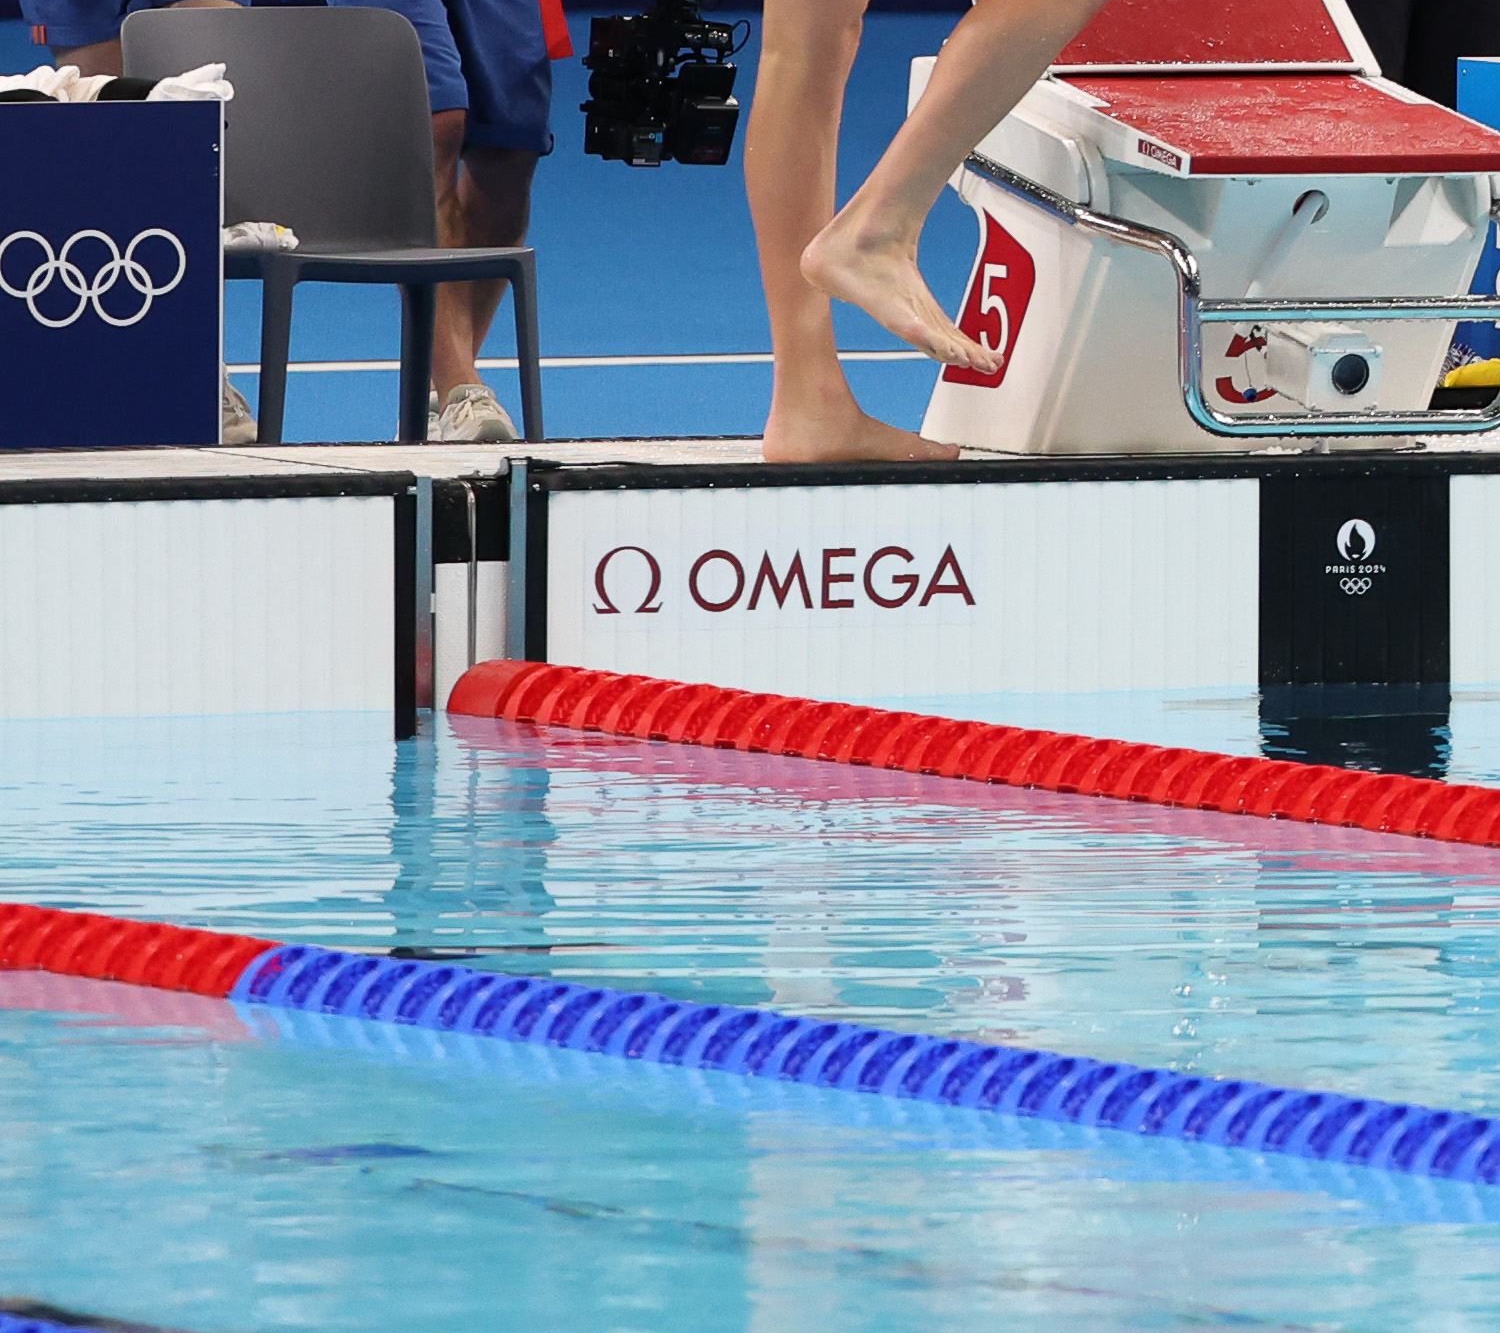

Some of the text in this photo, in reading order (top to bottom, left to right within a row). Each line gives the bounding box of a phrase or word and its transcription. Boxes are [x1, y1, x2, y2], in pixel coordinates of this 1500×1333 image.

[980, 263, 1010, 358] 5
[689, 544, 978, 613] OMEGA
[1325, 565, 1387, 574] PARIS 2024
